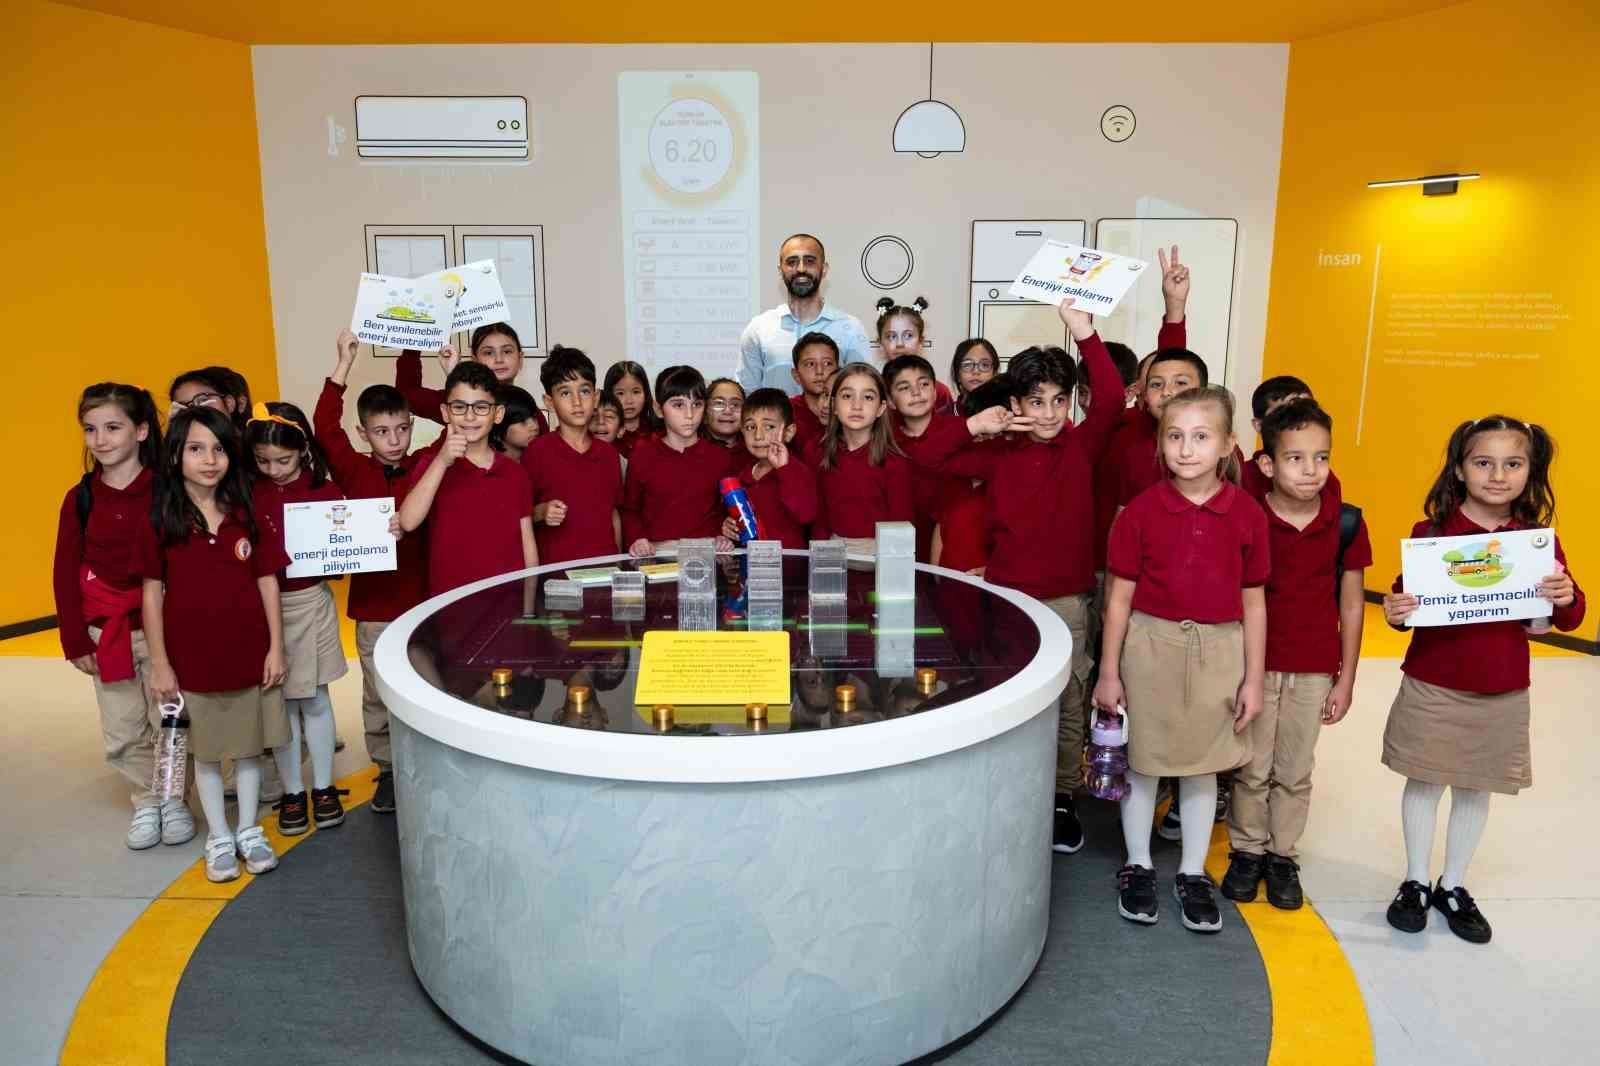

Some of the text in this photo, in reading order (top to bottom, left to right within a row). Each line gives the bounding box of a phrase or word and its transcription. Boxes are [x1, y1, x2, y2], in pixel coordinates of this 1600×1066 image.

[664, 139, 717, 163] 6.20
[1021, 275, 1113, 304] Enerjiyi saklarım
[363, 319, 443, 336] Ben yenilenebilir
[358, 331, 388, 343] enerji
[329, 533, 353, 544] Ben
[294, 545, 389, 560] enerji depolama
[323, 560, 361, 573] piliyim
[1416, 594, 1457, 606] Temiz
[1448, 607, 1510, 621] yaparım
